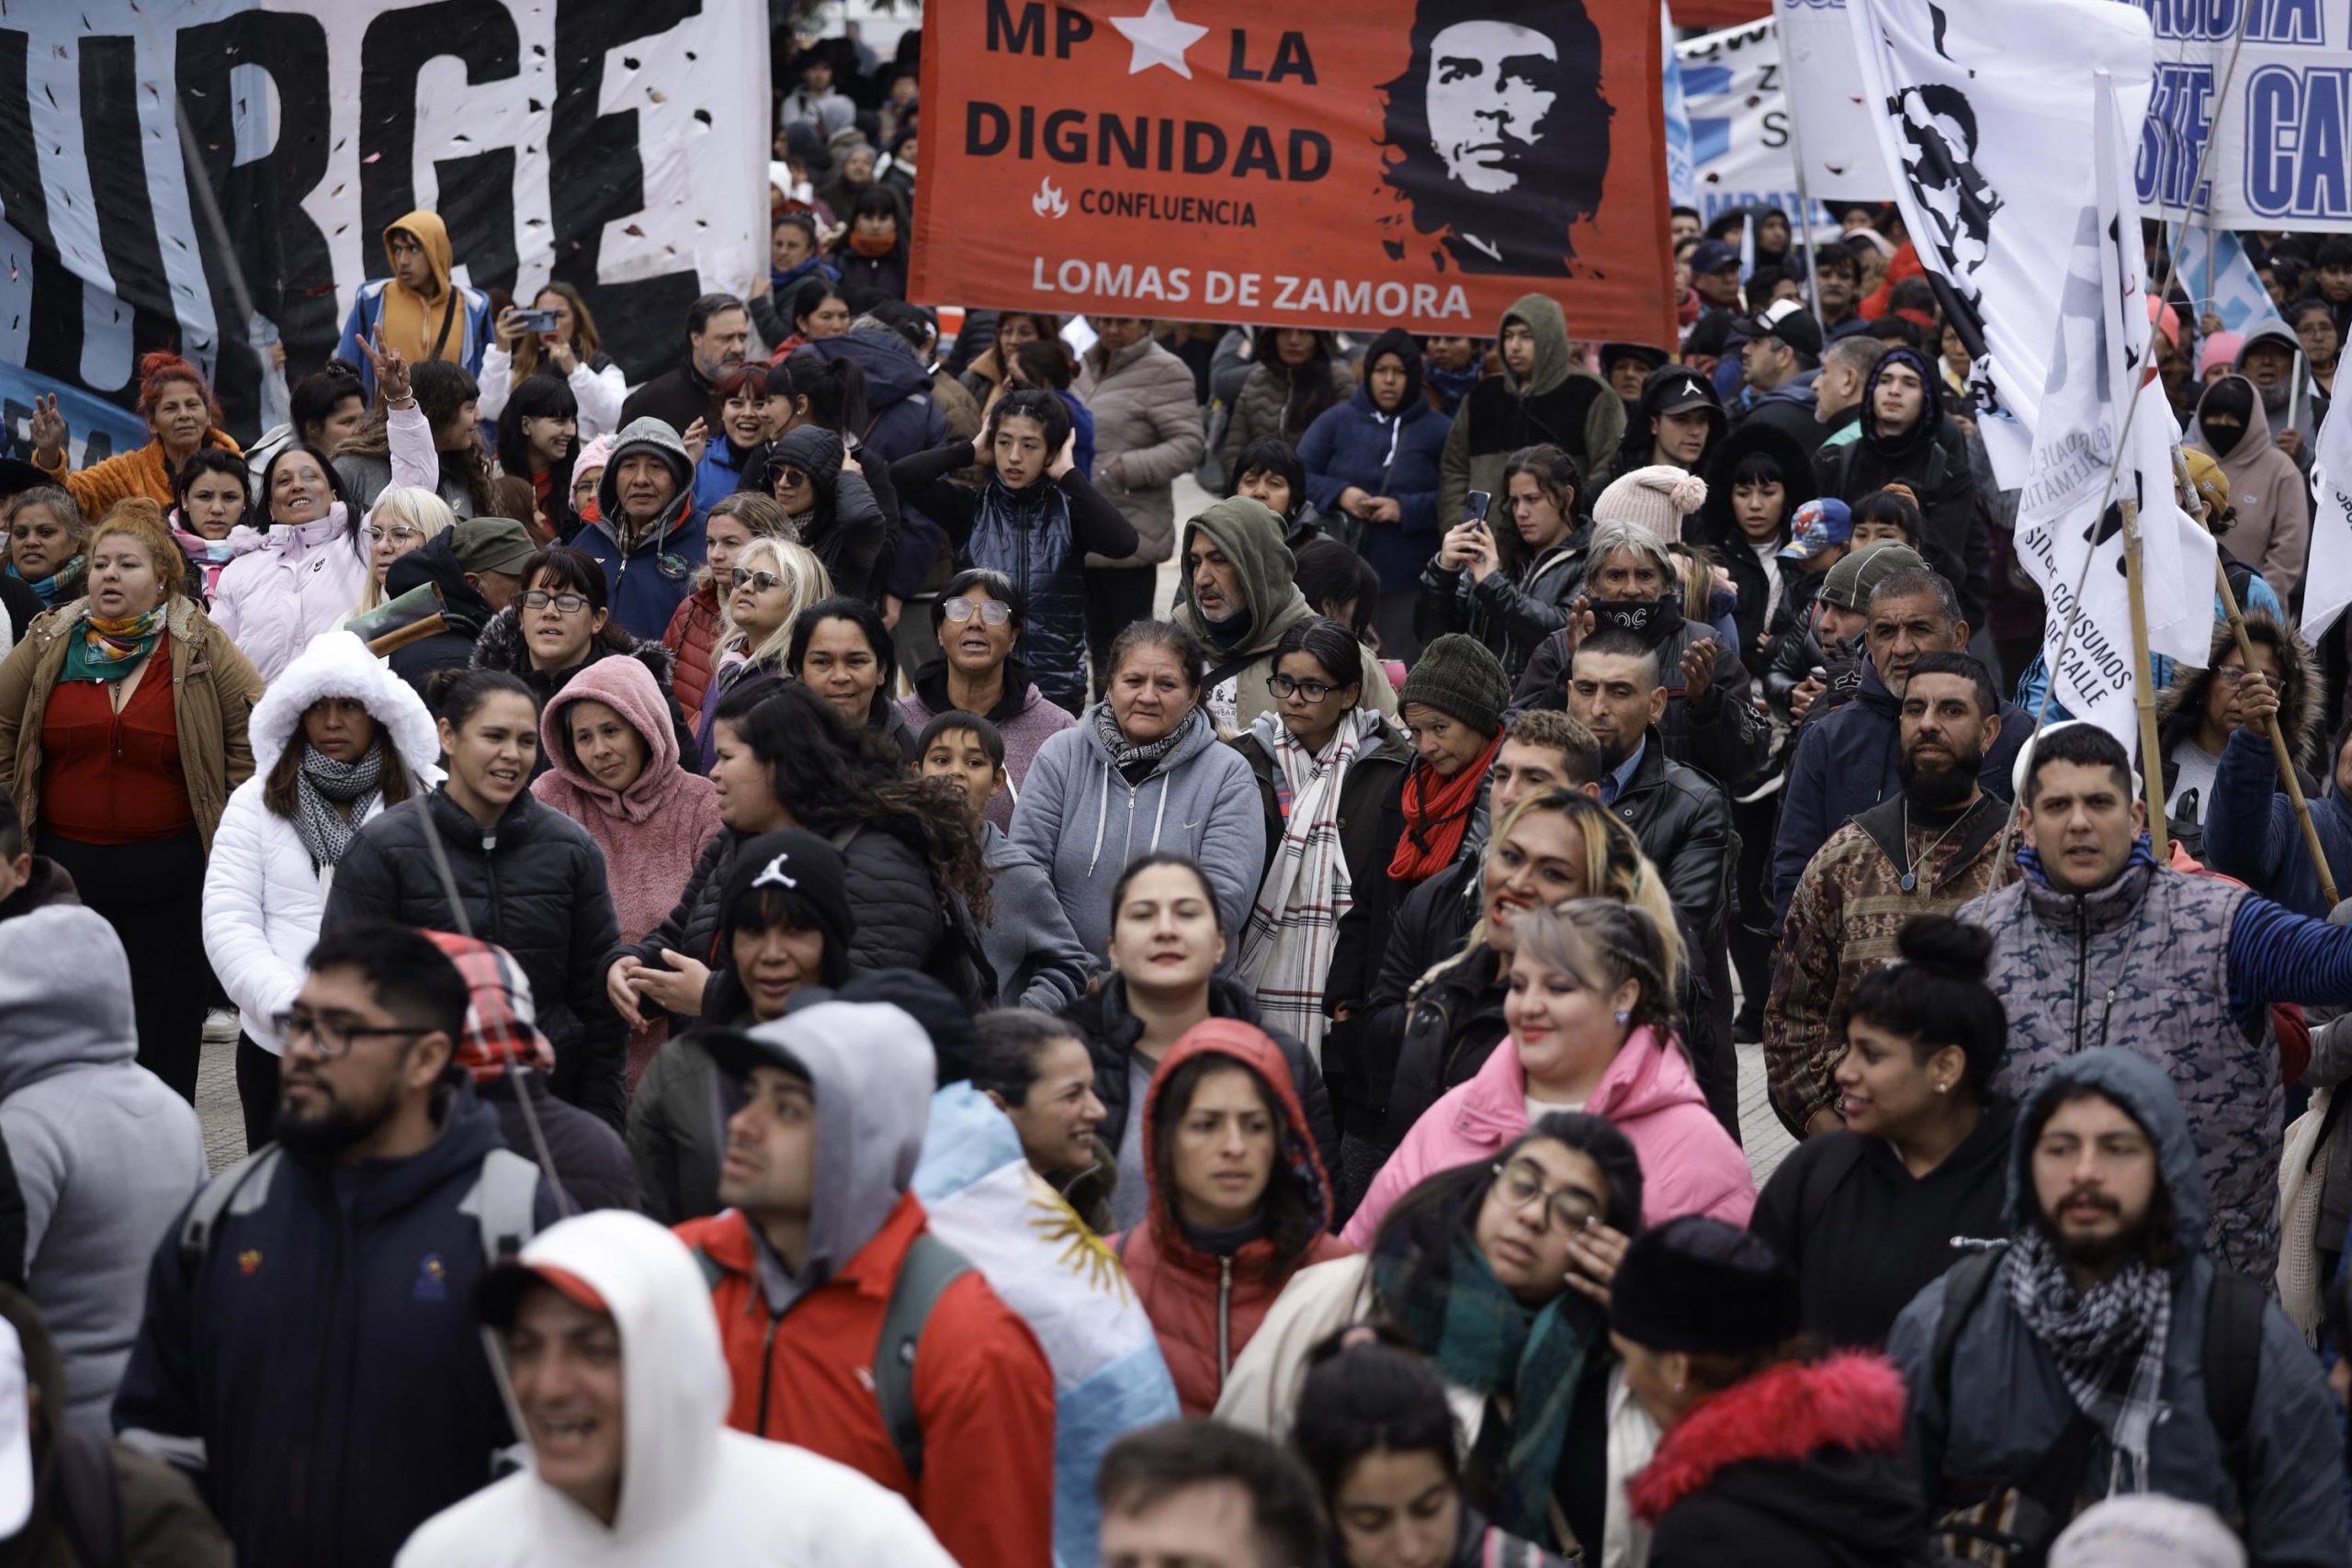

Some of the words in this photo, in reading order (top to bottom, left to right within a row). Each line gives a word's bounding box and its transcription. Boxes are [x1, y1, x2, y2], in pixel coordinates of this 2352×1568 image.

[986, 0, 1093, 60] MP
[1227, 28, 1317, 85] LA
[965, 101, 1332, 183] DIGNIDAD
[1080, 188, 1257, 227] CONFLUENCIA
[1032, 256, 1191, 302] LOMAS
[1204, 270, 1261, 307] DE
[1272, 276, 1472, 319] ZAMORA
[2052, 582, 2132, 691] CONSUMOS
[2059, 646, 2109, 708] CALLE
